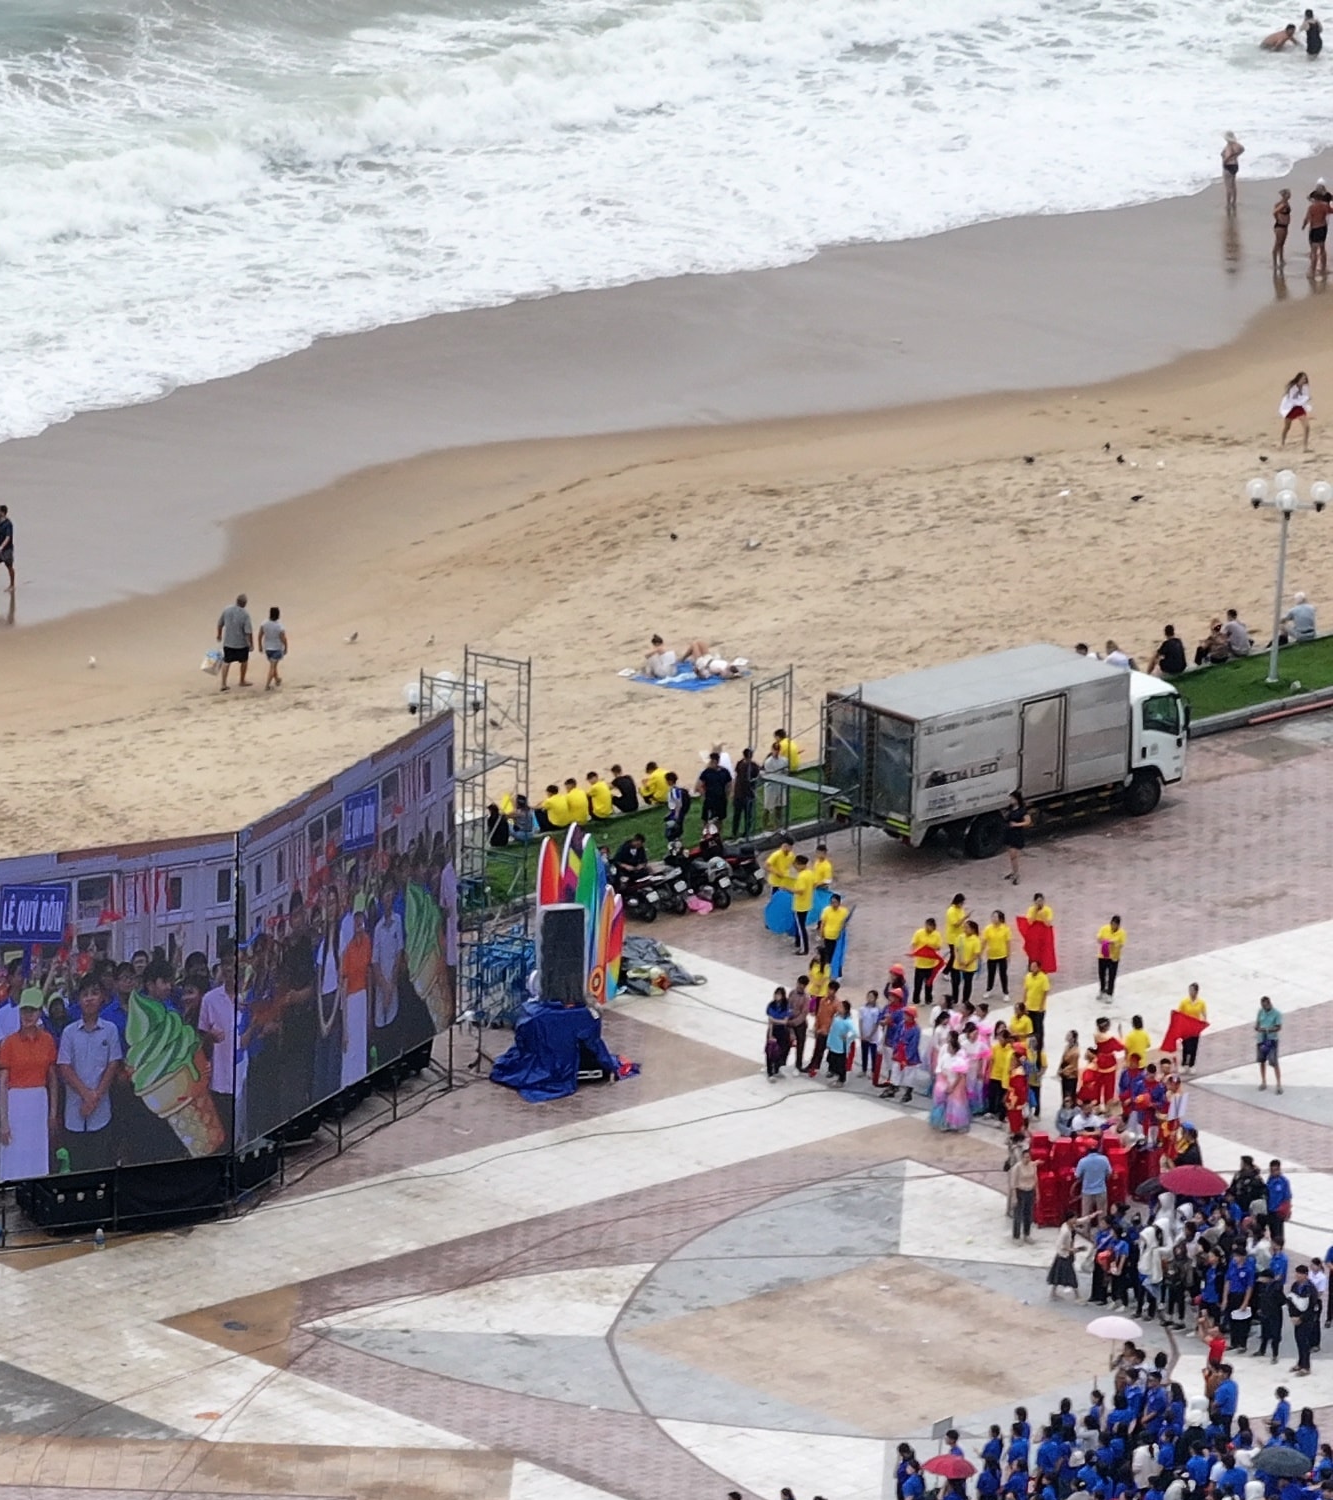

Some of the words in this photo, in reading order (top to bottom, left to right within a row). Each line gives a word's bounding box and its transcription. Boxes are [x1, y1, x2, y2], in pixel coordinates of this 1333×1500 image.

[2, 893, 16, 932] LÊ
[17, 893, 39, 936] QUÝ
[39, 893, 64, 933] ĐÔN
